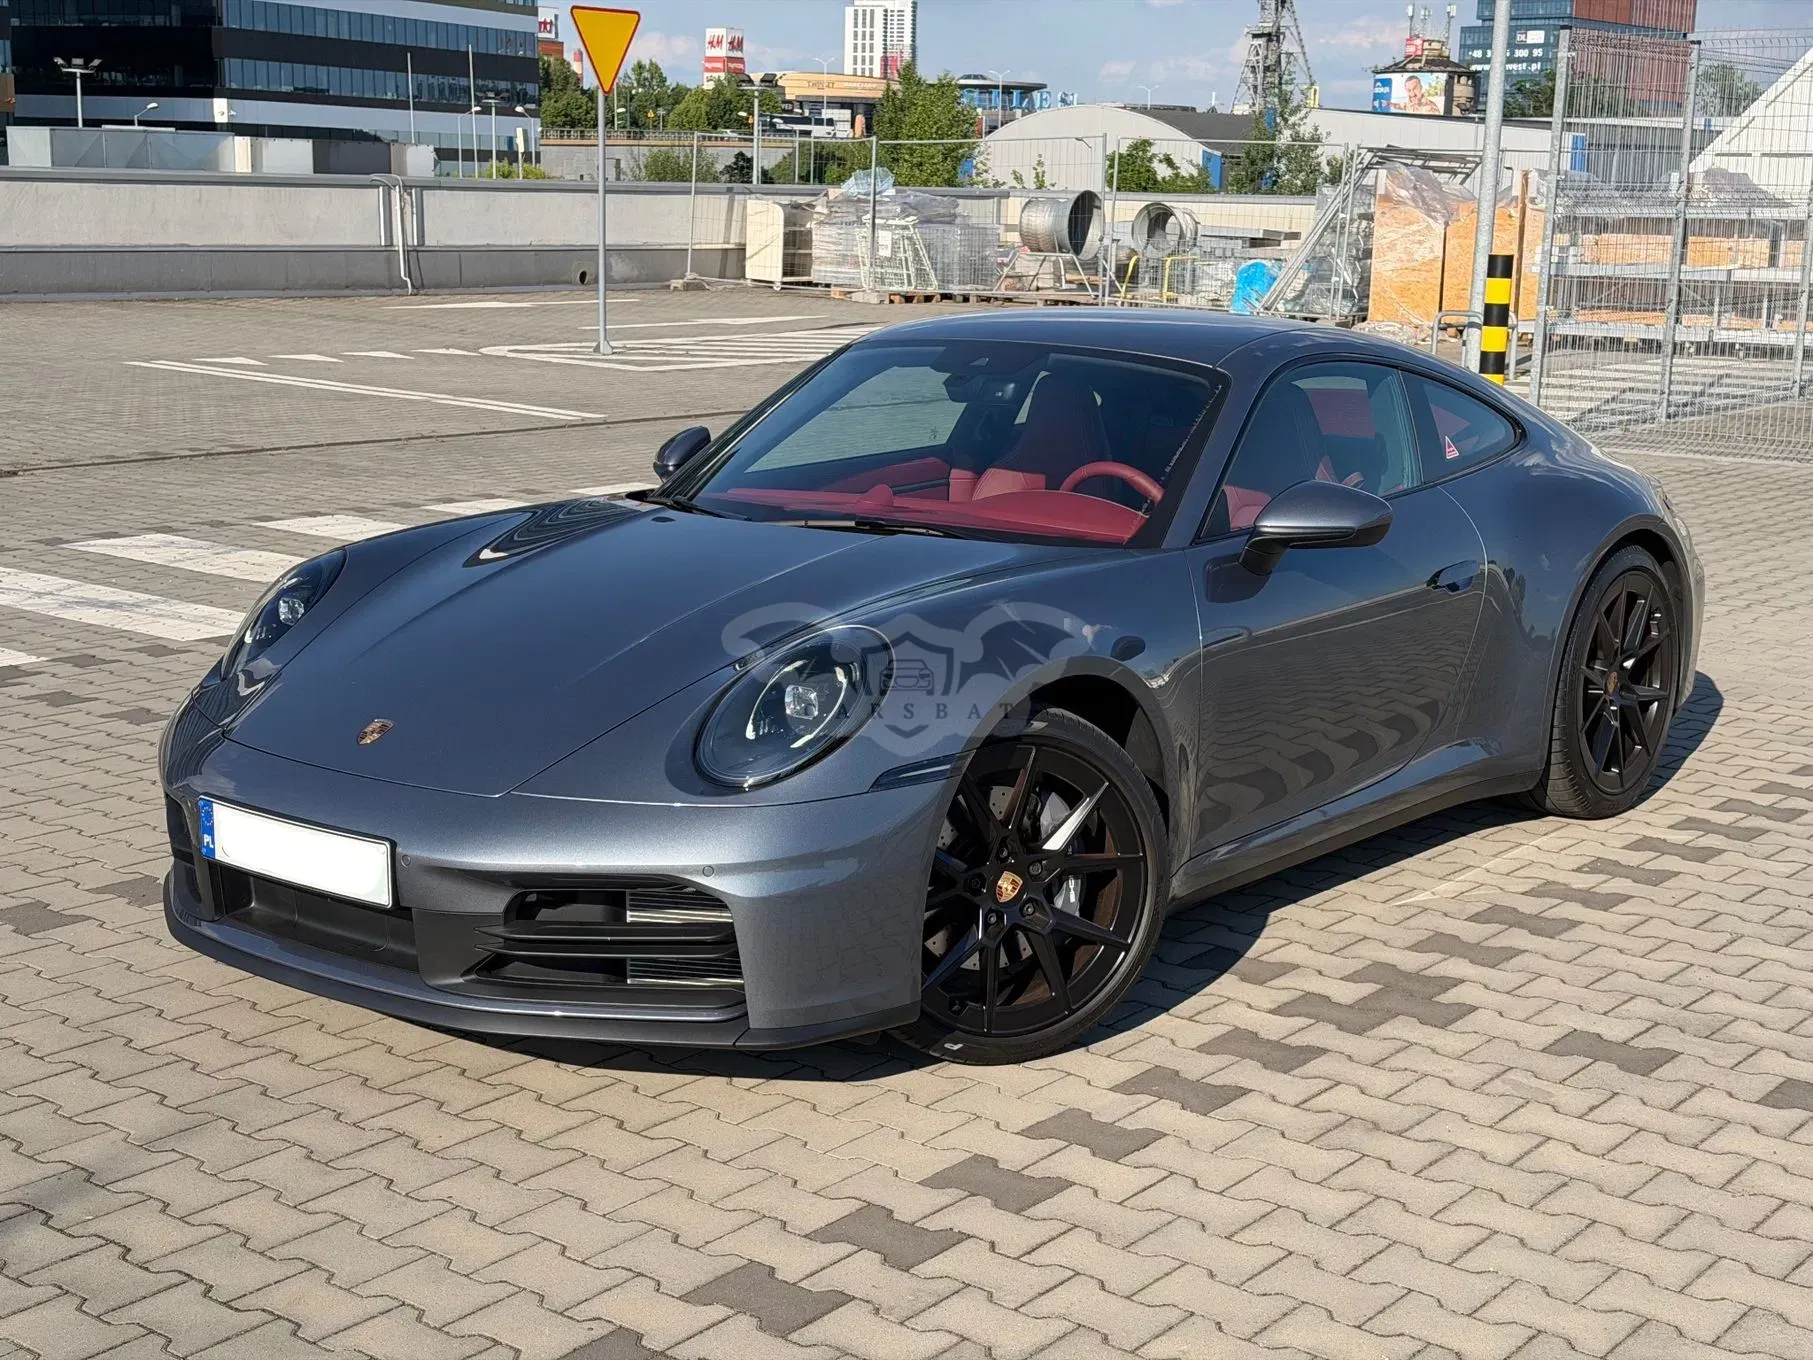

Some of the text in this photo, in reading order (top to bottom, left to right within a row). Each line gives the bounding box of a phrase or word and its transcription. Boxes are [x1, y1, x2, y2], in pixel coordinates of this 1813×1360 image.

[1513, 49, 1529, 58] 300
[1532, 48, 1543, 57] 95
[203, 833, 214, 849] PL
